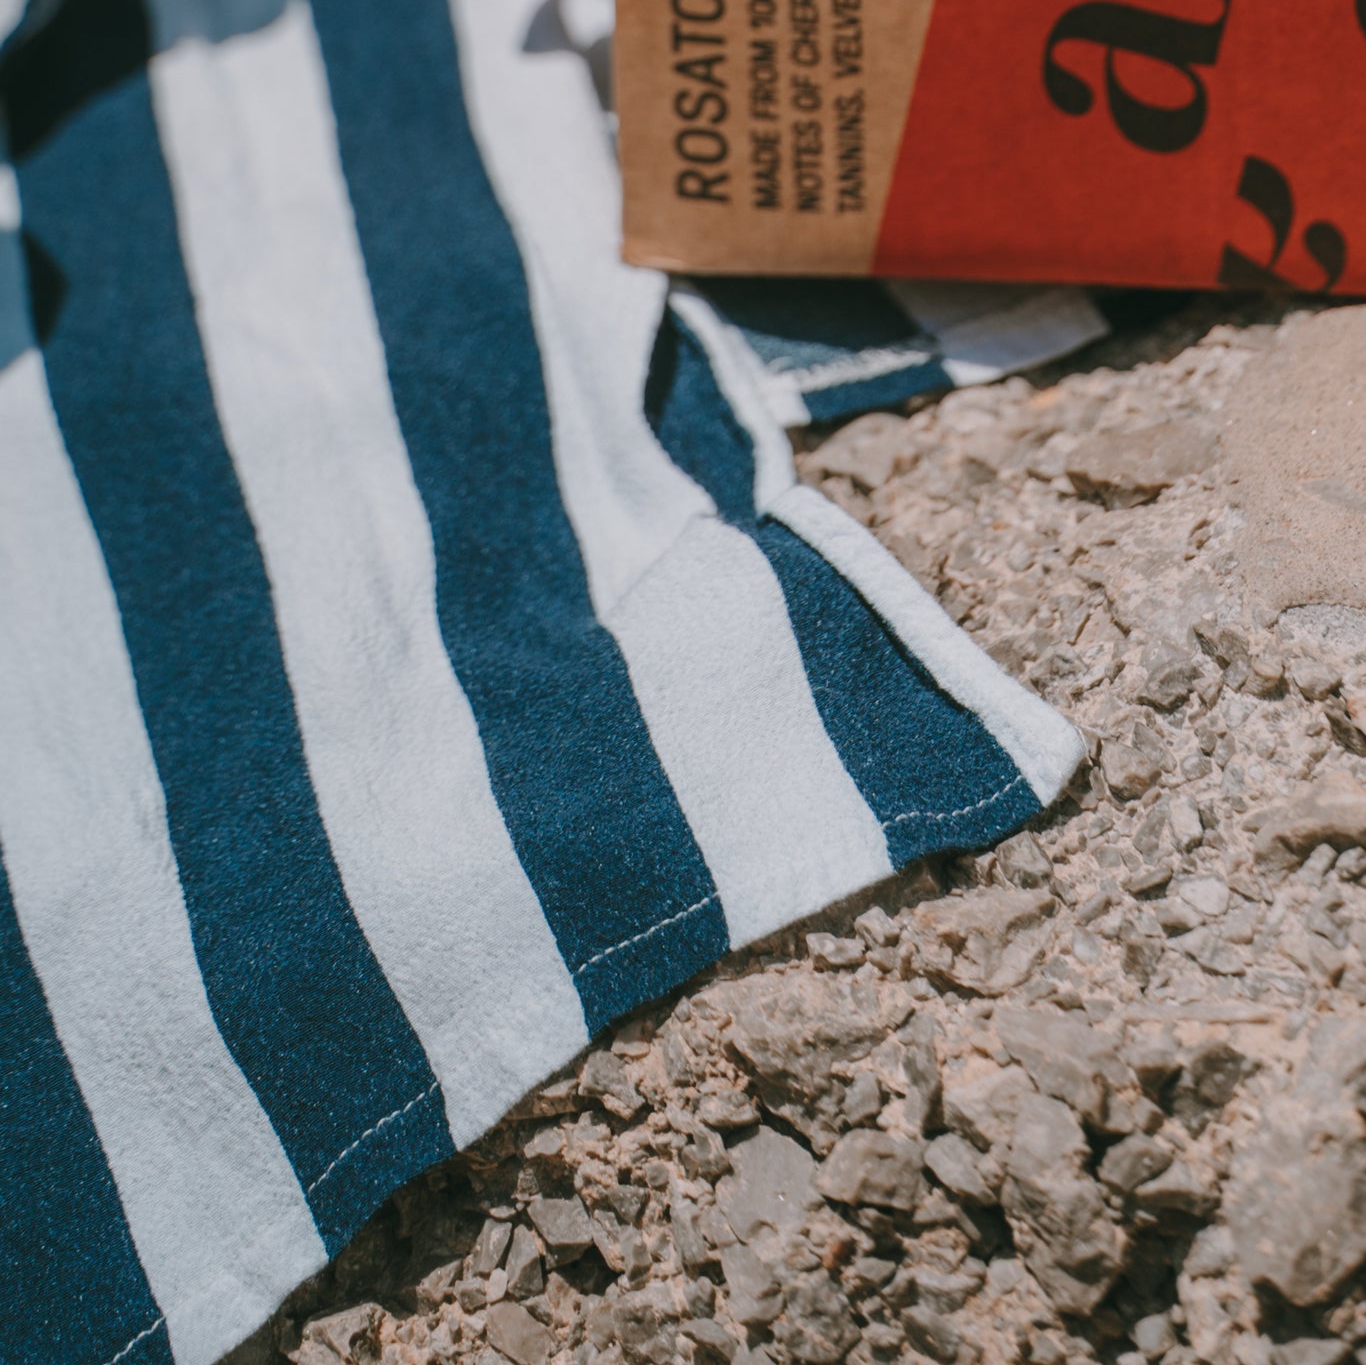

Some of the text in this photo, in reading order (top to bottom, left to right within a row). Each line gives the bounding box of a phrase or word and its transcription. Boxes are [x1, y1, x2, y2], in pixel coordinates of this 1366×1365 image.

[750, 40, 778, 121] FROM
[791, 76, 822, 112] OF
[752, 133, 781, 210] MADE
[793, 121, 822, 212] NOTES
[835, 91, 865, 213] TANNINS.
